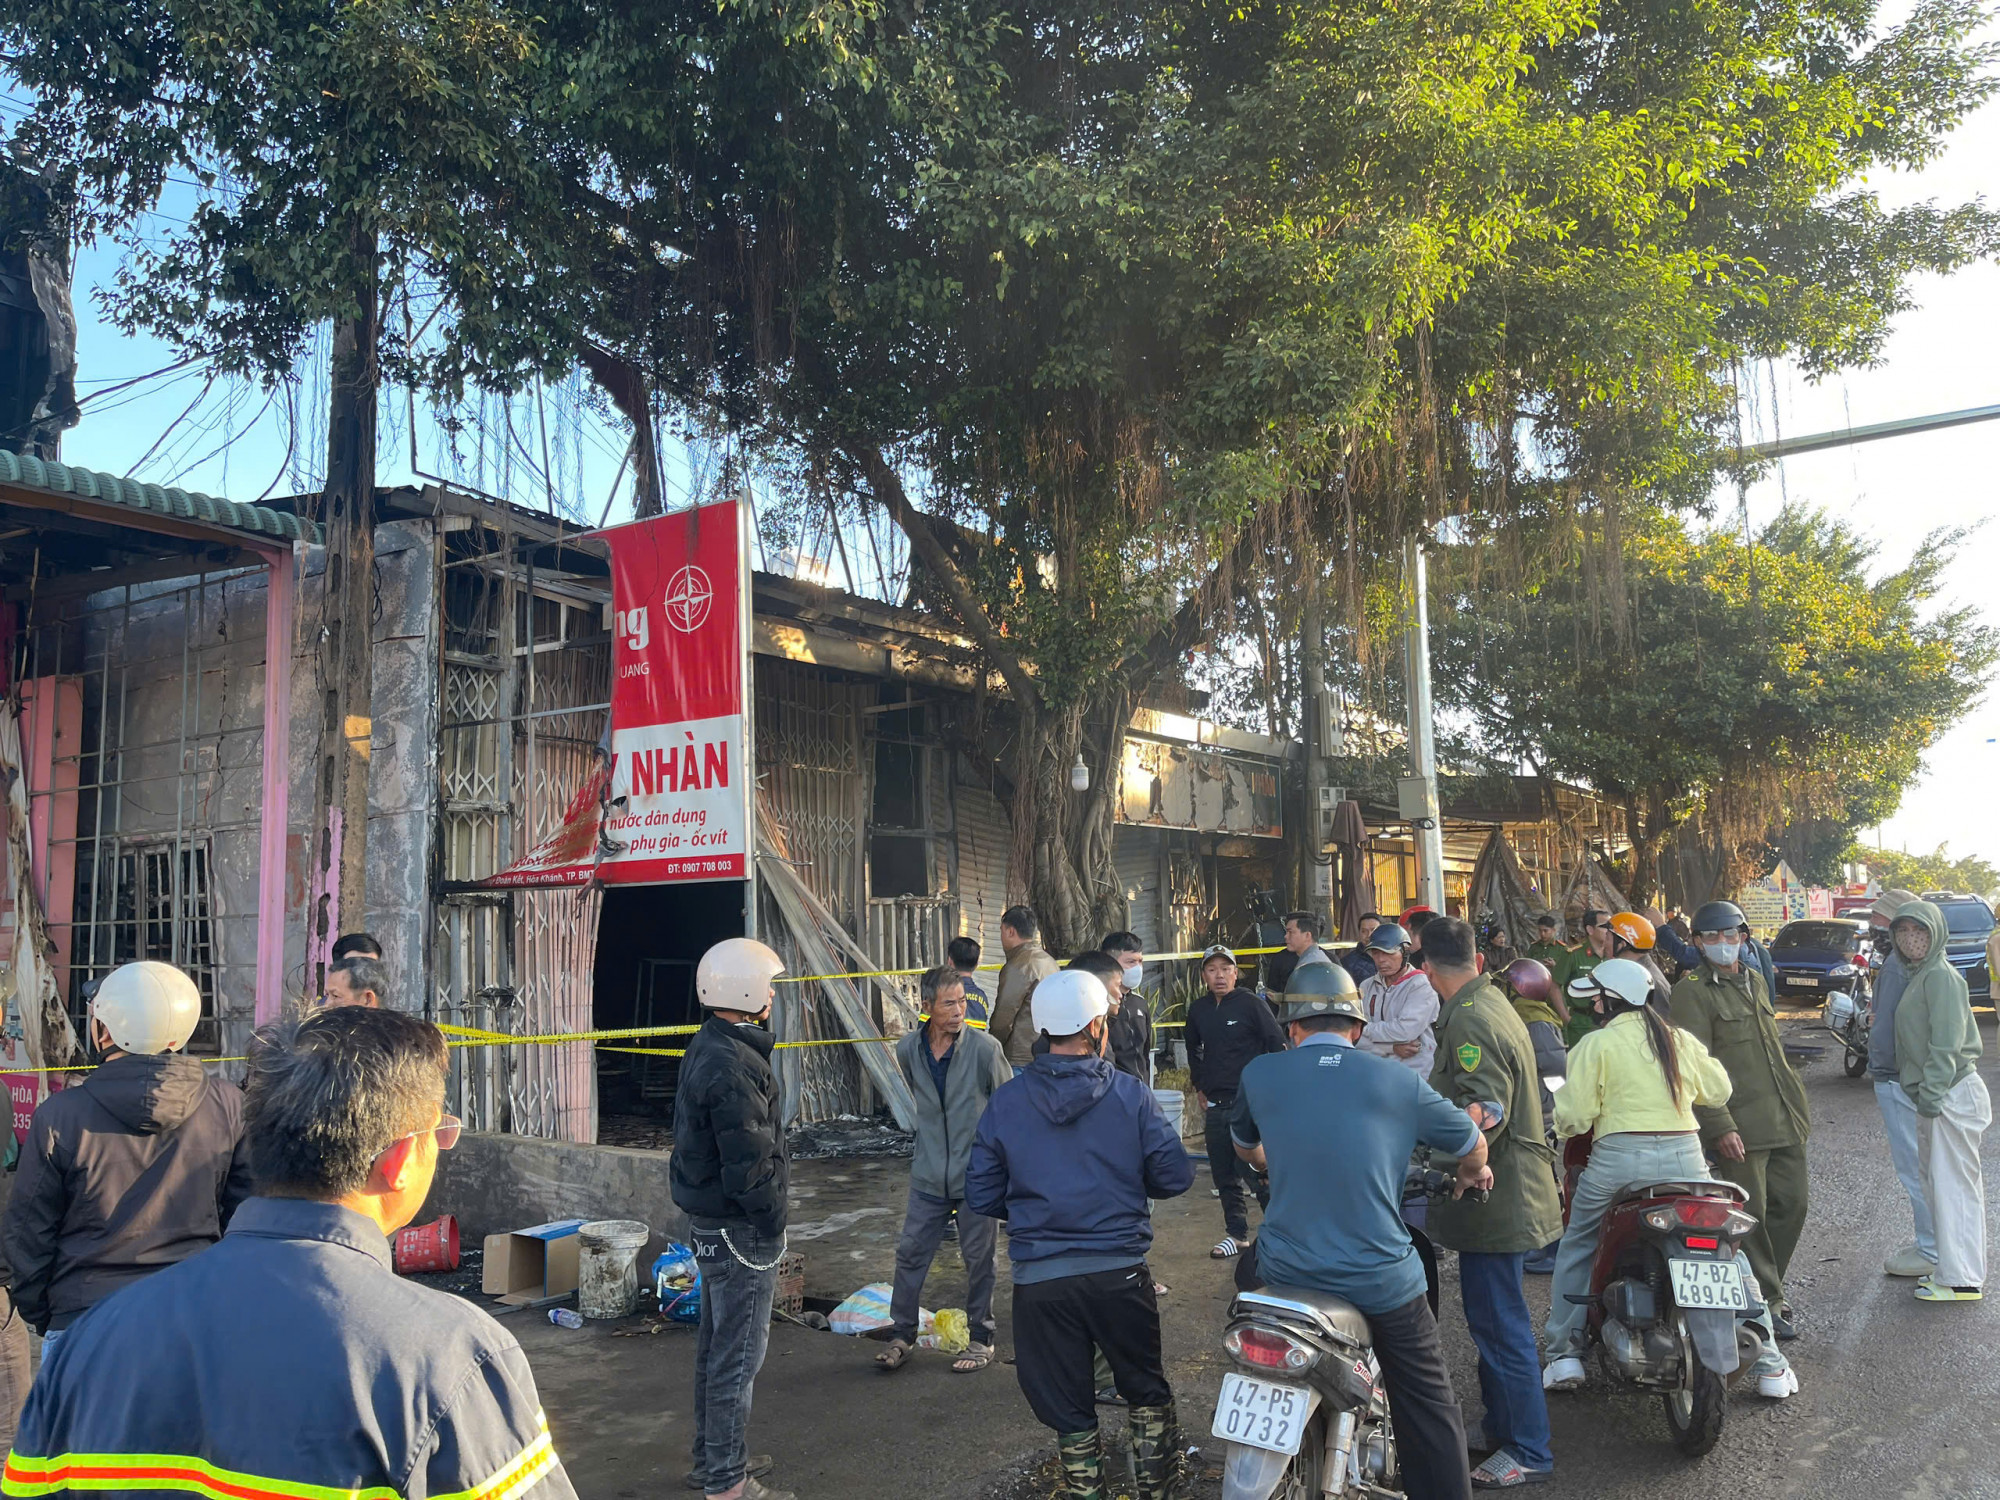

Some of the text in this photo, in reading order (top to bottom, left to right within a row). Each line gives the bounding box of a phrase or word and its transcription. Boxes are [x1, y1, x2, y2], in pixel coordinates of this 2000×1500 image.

[631, 731, 729, 797] NHÀN
[609, 808, 707, 831] nước dân dụng
[630, 834, 657, 855] phụ
[659, 832, 680, 853] gia
[691, 828, 708, 847] ốc
[710, 828, 728, 845] vít
[540, 872, 565, 883] Khánh,
[566, 871, 577, 881] TP.
[668, 860, 732, 874] ĐT: 0907 708 003
[12, 1085, 33, 1104] HÒA
[12, 1112, 32, 1130] 335
[1682, 1262, 1732, 1284] 47-B2
[1679, 1284, 1743, 1306] 489.46
[1232, 1380, 1296, 1417] 47-P5
[1226, 1408, 1290, 1447] 0732
